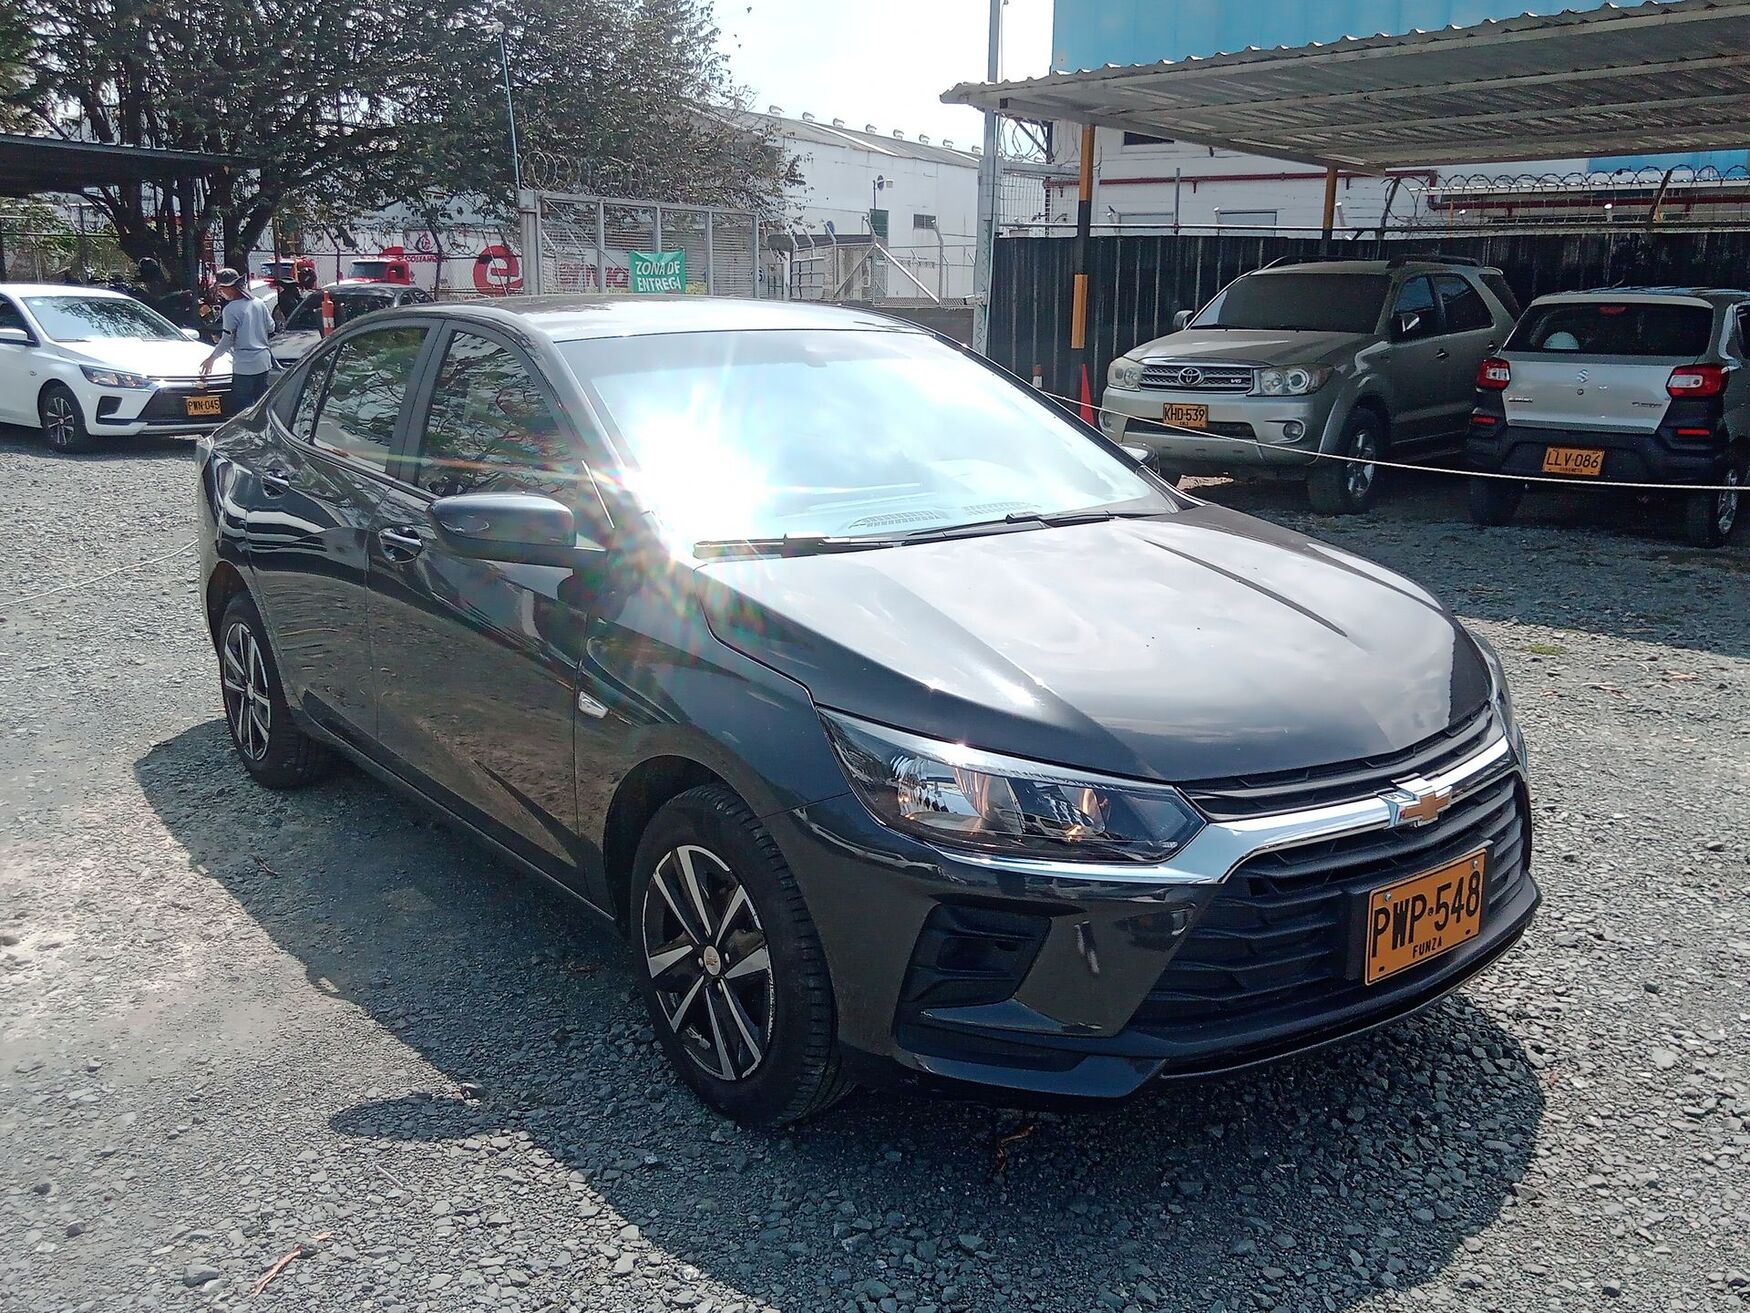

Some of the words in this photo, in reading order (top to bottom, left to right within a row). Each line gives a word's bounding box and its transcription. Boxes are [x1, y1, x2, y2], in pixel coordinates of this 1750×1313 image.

[635, 261, 665, 276] ZONA
[667, 260, 681, 275] DE
[1412, 936, 1442, 959] FUNZA
